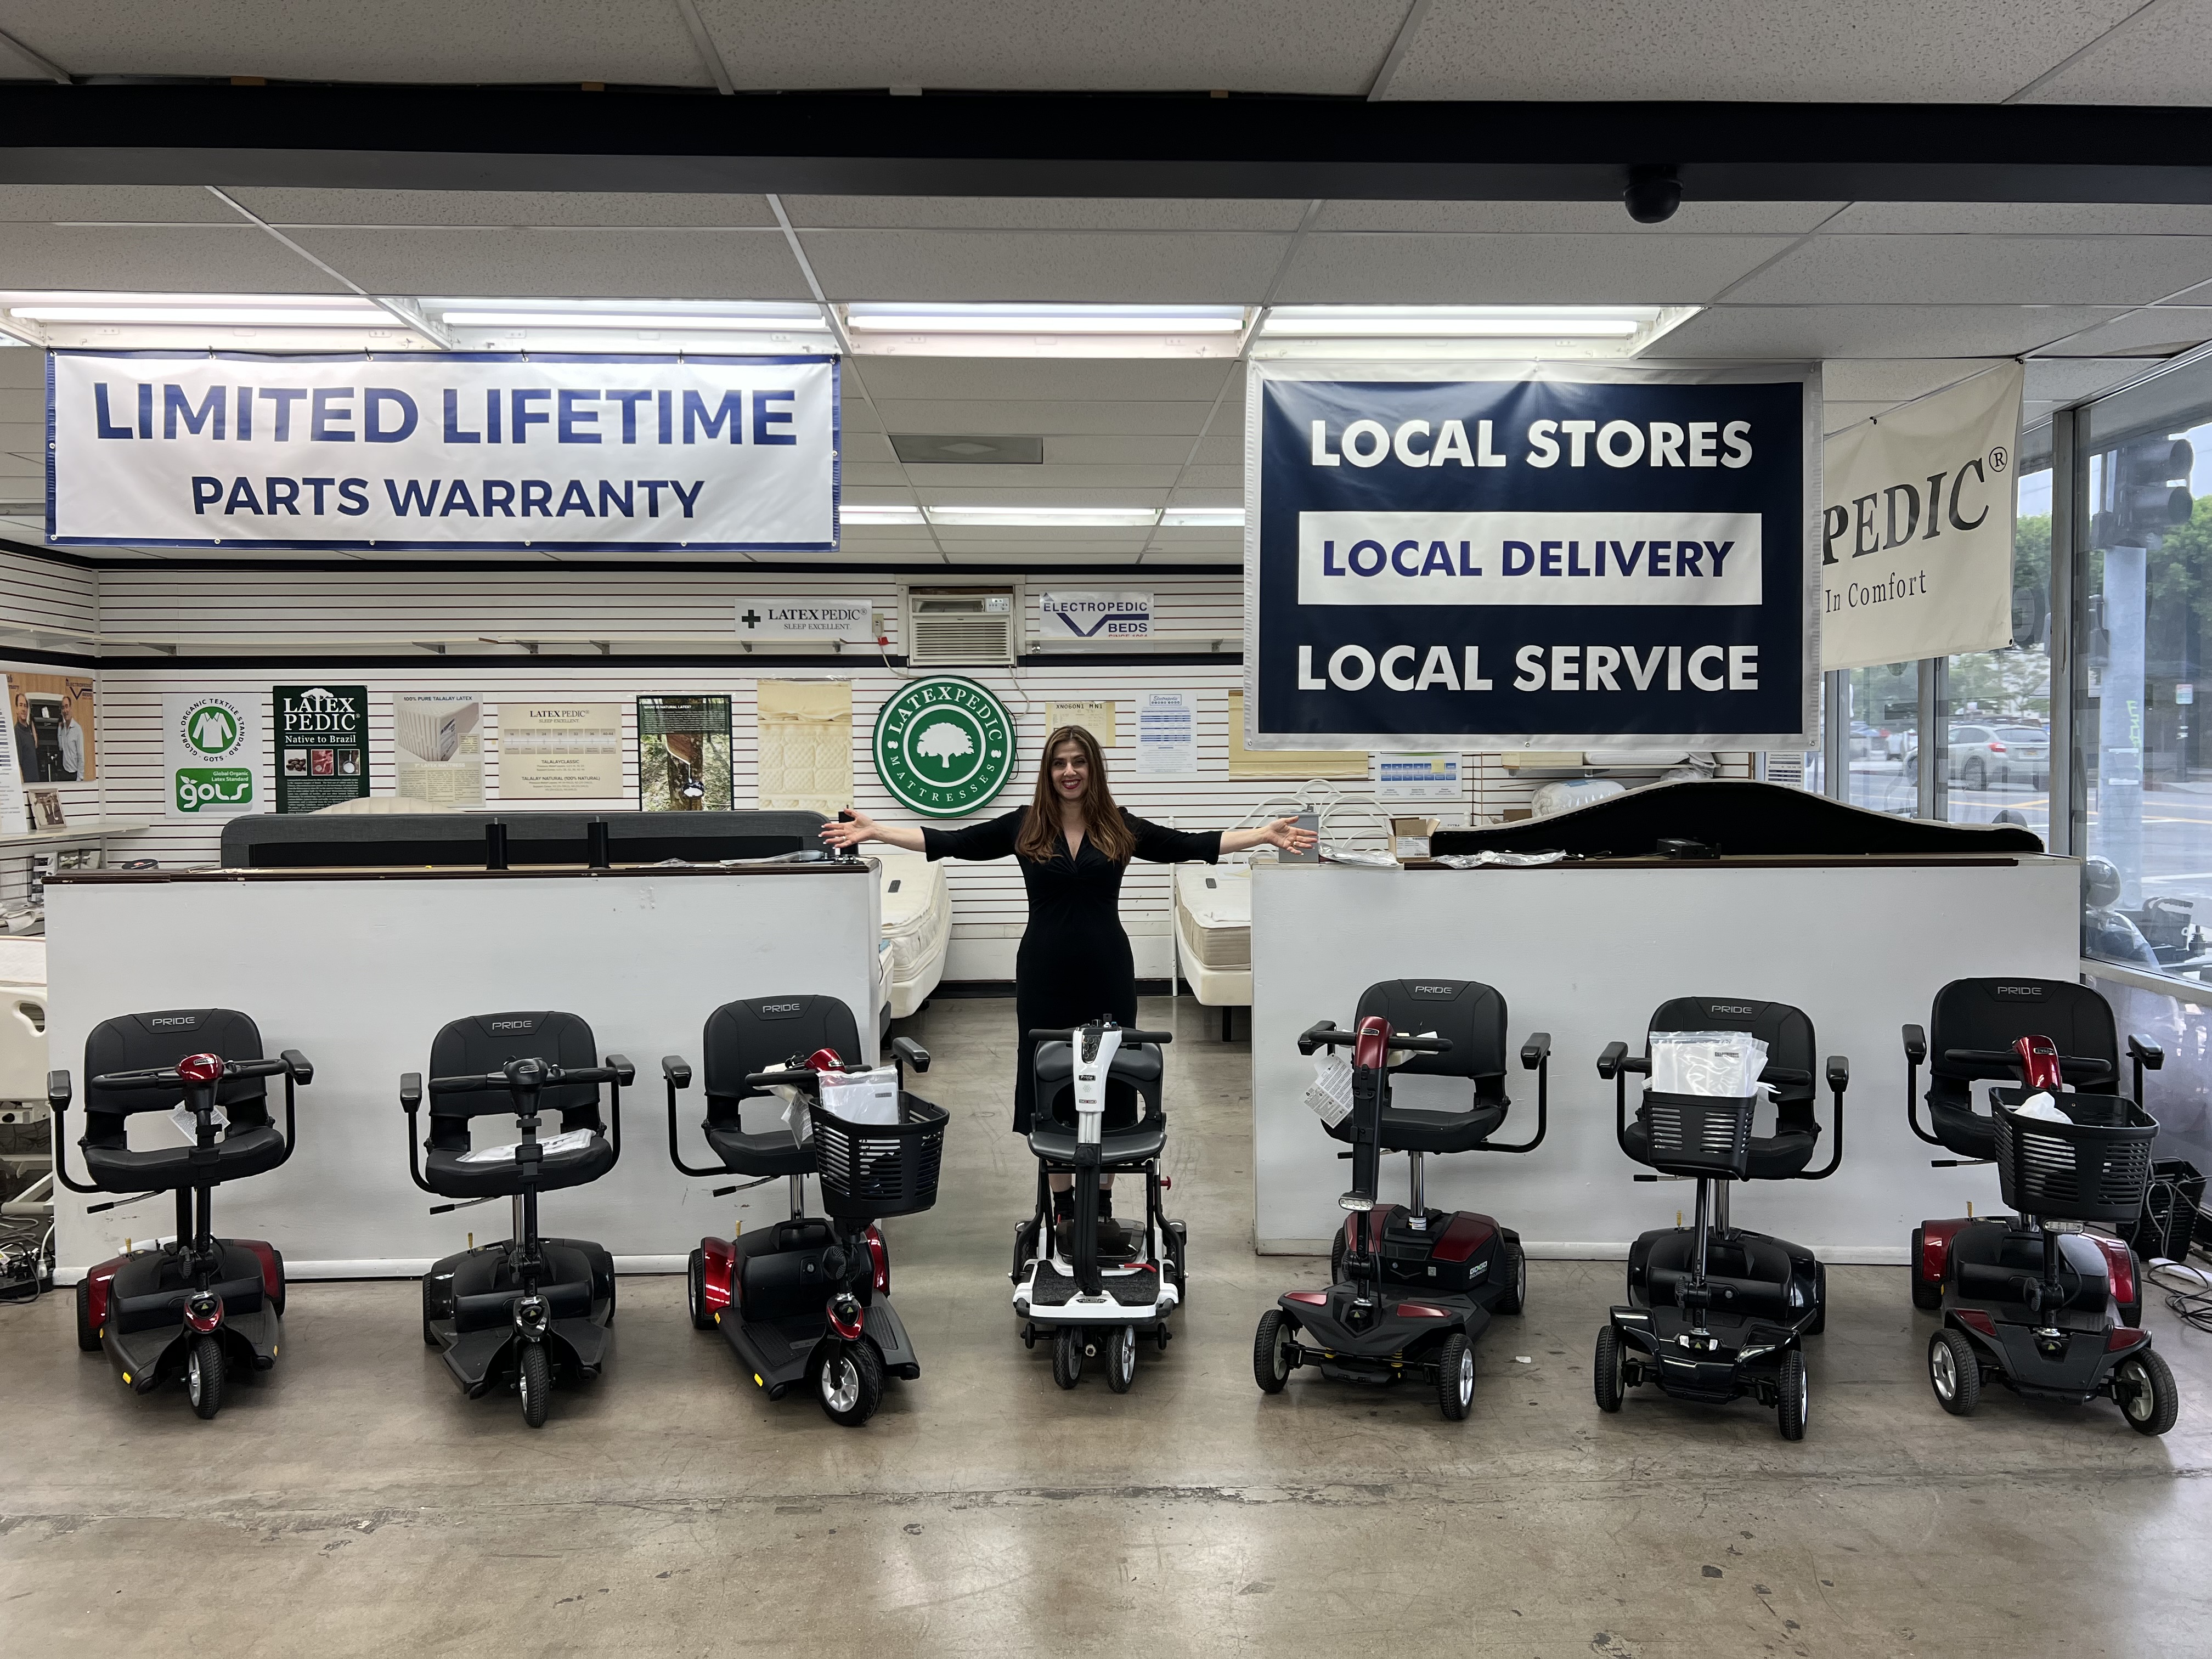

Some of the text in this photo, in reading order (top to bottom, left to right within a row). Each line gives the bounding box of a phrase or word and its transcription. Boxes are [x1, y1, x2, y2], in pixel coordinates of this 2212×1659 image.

[95, 383, 797, 445] LIMITED LIFETIME
[1312, 420, 1752, 469] LOCAL STORES
[192, 477, 705, 518] PARTS WARRANTY
[1323, 540, 1735, 577] LOCAL DELIVERY
[1825, 570, 1926, 613] In Comfort
[768, 609, 819, 620] LATEX
[1043, 602, 1148, 612] ELECTROPEDIC
[1108, 623, 1148, 633] BEDS
[1298, 645, 1758, 692] LOCAL SERVICE
[283, 697, 356, 713] LATEX
[888, 686, 1002, 741] LATEXPEDIC
[180, 698, 245, 756] GLOBAL ORGANIC TEXTILE STANDARD
[890, 755, 995, 802] MATTRESSES
[1415, 986, 1453, 994] PRIDE
[1997, 986, 2042, 995] PRIDE
[763, 1003, 800, 1013] PRIDE
[1711, 1005, 1752, 1014] PRIDE
[152, 1016, 195, 1026] PRIDE
[492, 1020, 532, 1030] PRIDE
